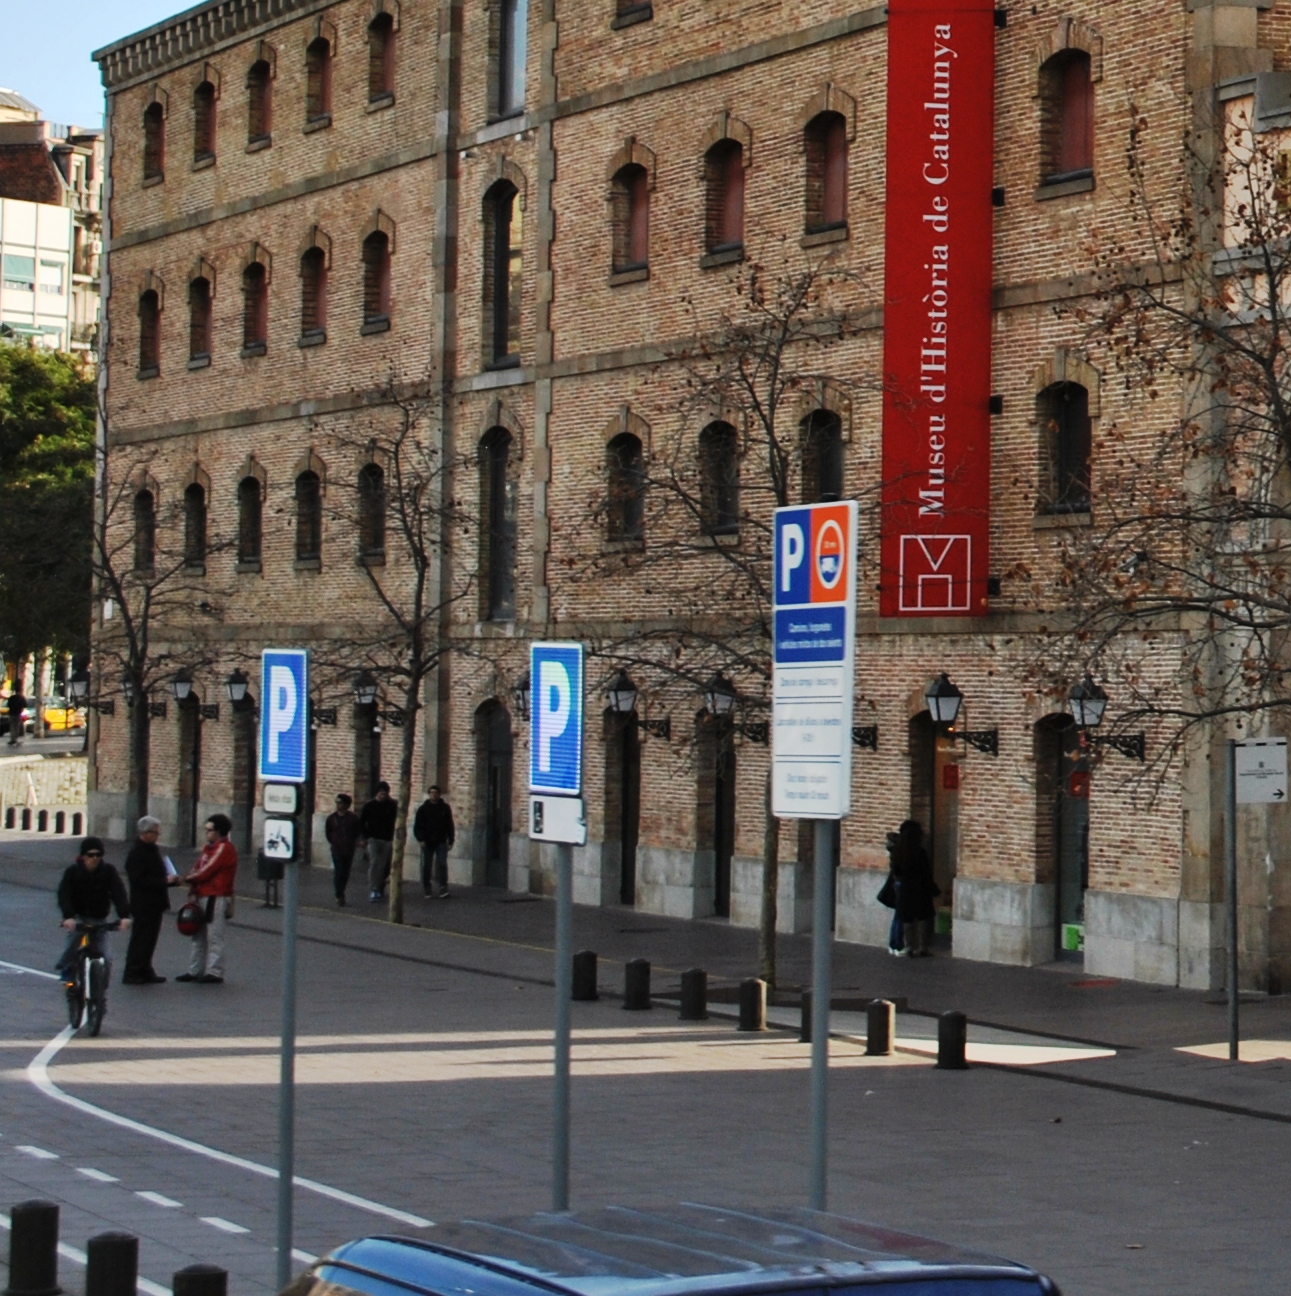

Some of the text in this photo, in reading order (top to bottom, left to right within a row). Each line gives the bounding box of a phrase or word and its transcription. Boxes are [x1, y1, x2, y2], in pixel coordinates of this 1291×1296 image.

[917, 23, 959, 518] Museu d'Història de Catalunya
[780, 523, 805, 592] P
[268, 665, 297, 763] P
[539, 661, 571, 772] P
